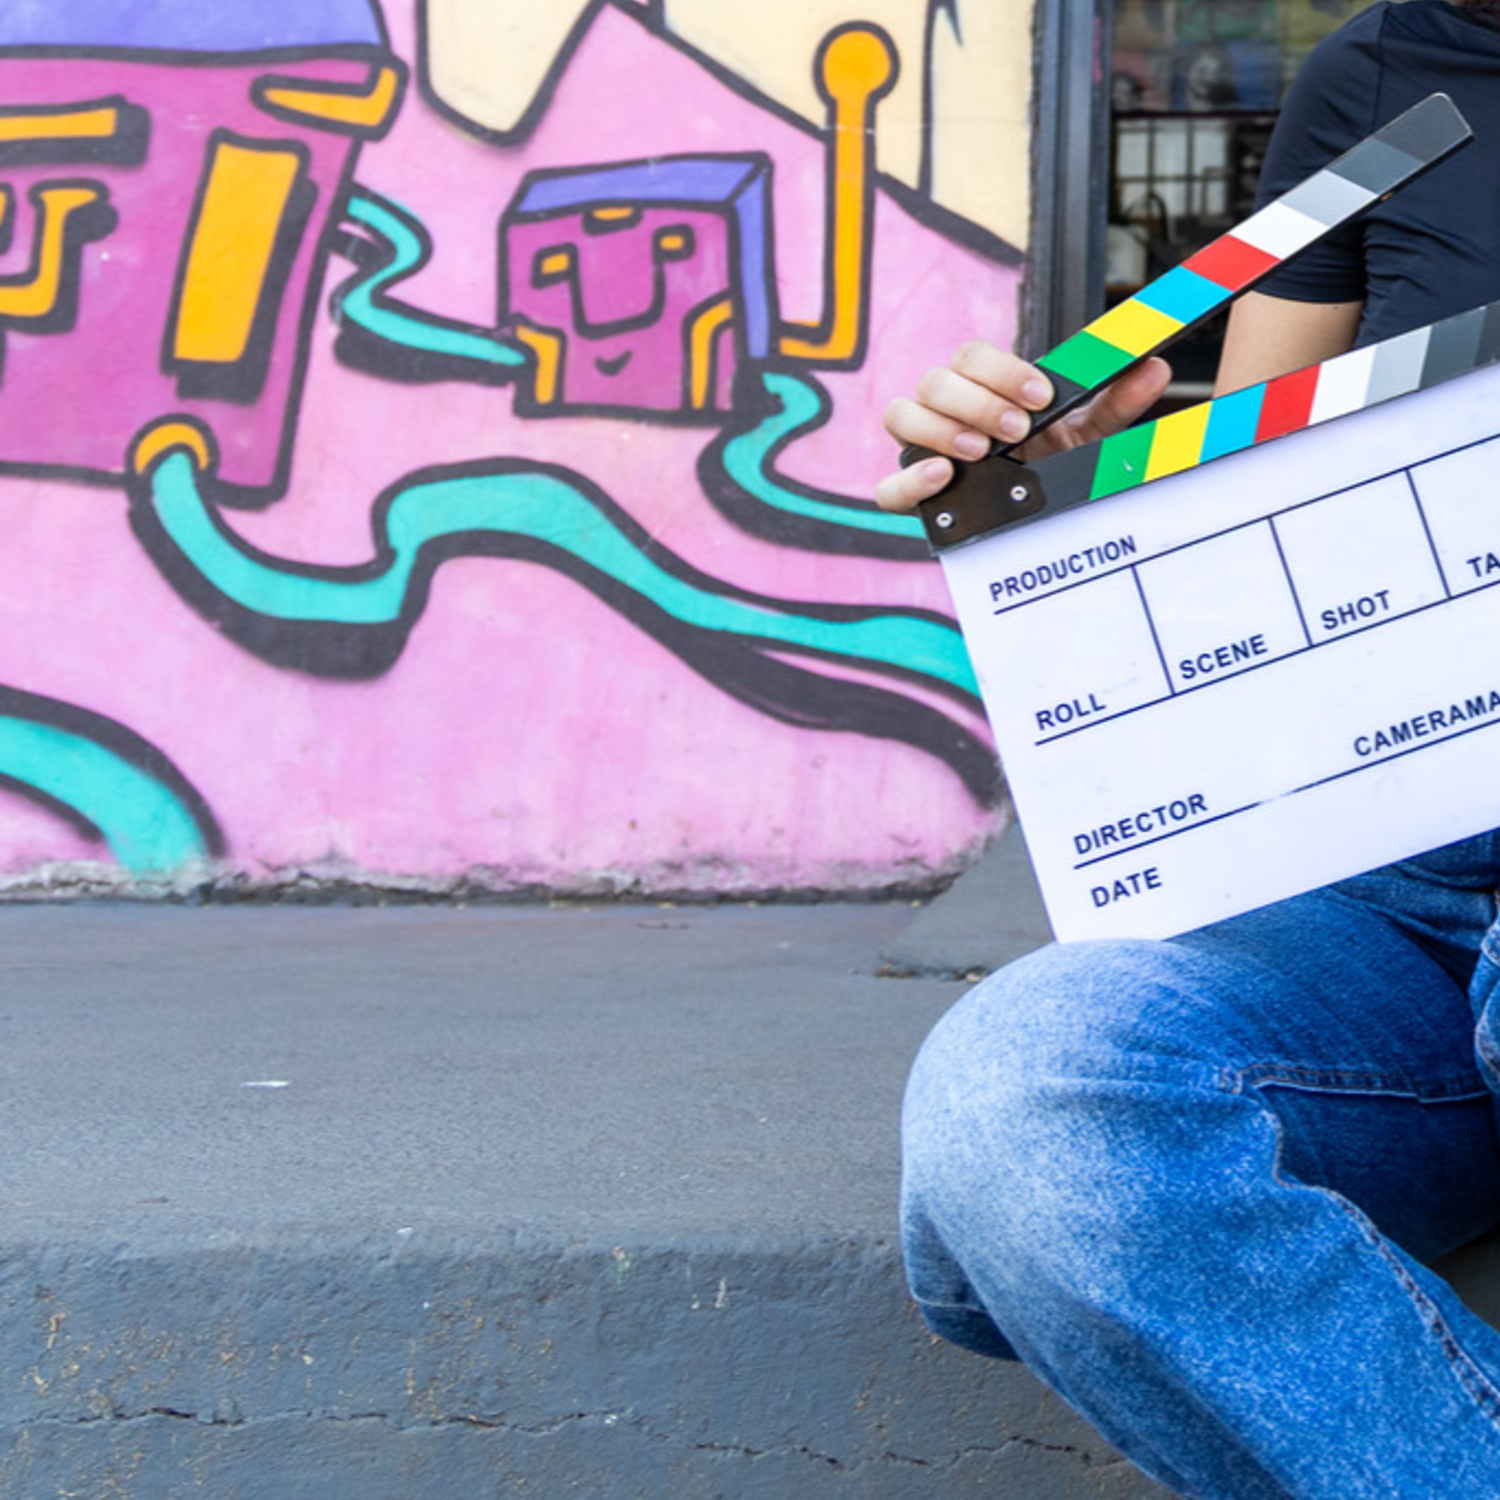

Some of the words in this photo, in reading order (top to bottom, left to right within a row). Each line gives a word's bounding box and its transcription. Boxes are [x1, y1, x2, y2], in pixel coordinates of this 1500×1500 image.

[989, 535, 1138, 602] PRODUCTION
[1320, 589, 1390, 630] SHOT
[1179, 633, 1268, 679] SCENE
[1034, 693, 1107, 731] ROLL
[1073, 793, 1208, 855] DIRECTOR
[1090, 866, 1163, 908] DATE
